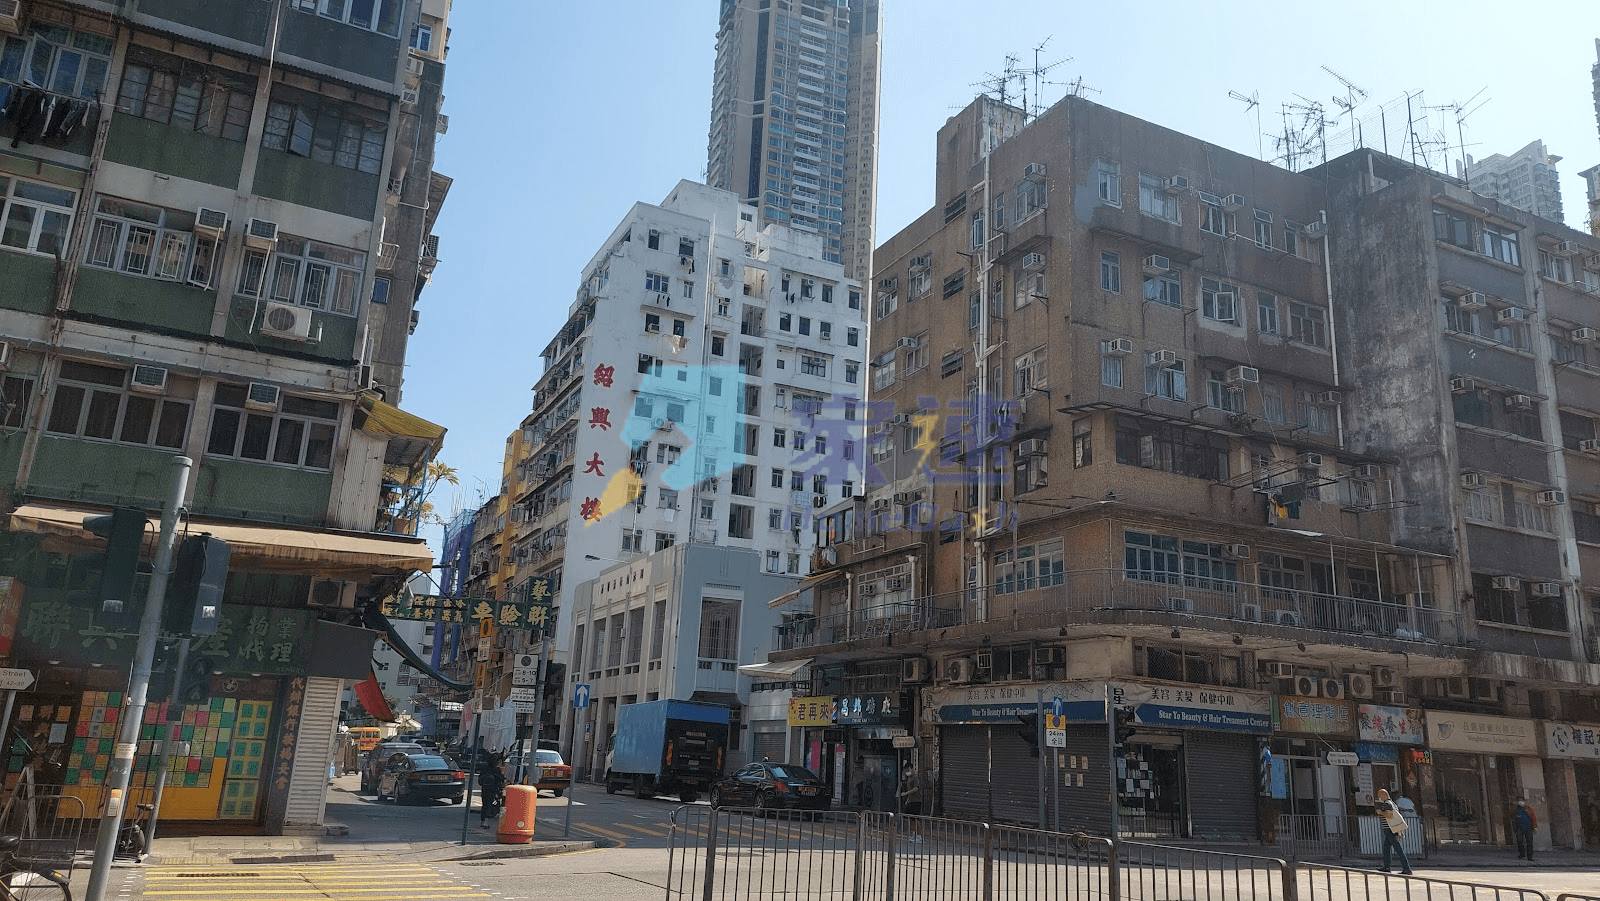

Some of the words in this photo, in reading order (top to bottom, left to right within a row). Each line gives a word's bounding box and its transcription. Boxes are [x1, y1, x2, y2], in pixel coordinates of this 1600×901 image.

[2, 669, 27, 678] Street
[1150, 688, 1170, 701] 美容
[1199, 692, 1235, 707] 保健中心
[797, 702, 829, 721] 君再來
[1158, 710, 1172, 720] Star
[1172, 710, 1181, 720] Yo
[1181, 711, 1202, 723] Beauty
[1208, 713, 1221, 723] Hair
[1222, 715, 1250, 726] Treament
[1250, 717, 1270, 728] Center
[1051, 737, 1063, 746] 全日
[1572, 728, 1600, 745] 權記
